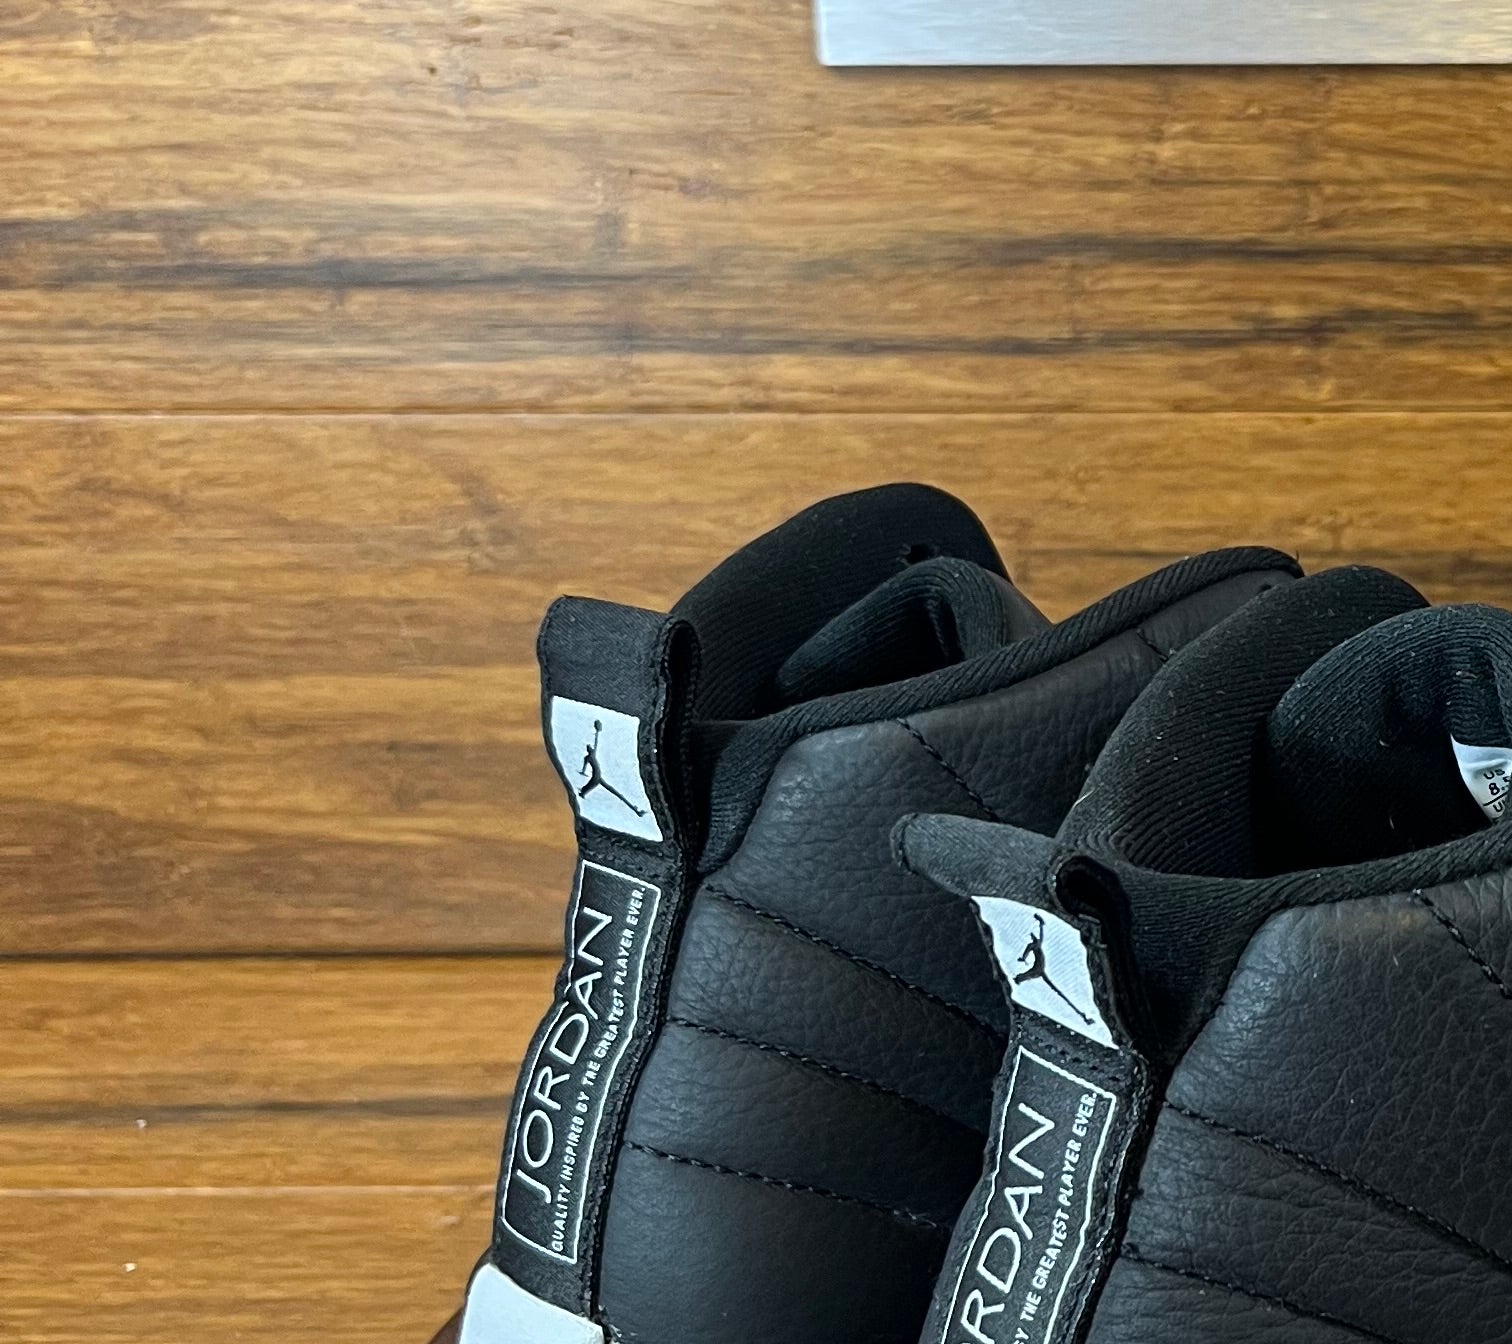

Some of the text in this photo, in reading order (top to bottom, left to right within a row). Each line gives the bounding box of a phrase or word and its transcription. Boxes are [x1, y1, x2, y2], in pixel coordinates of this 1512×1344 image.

[516, 907, 613, 1203] JORDAN
[551, 887, 646, 1252] QUALITY INSPIRED BY THE GREATEST PLAYER EVER.
[1020, 1291, 1042, 1322] THE
[1032, 1208, 1070, 1289] GREATEST
[1058, 1139, 1082, 1206] PLAYER
[1072, 1092, 1098, 1137] EVER.
